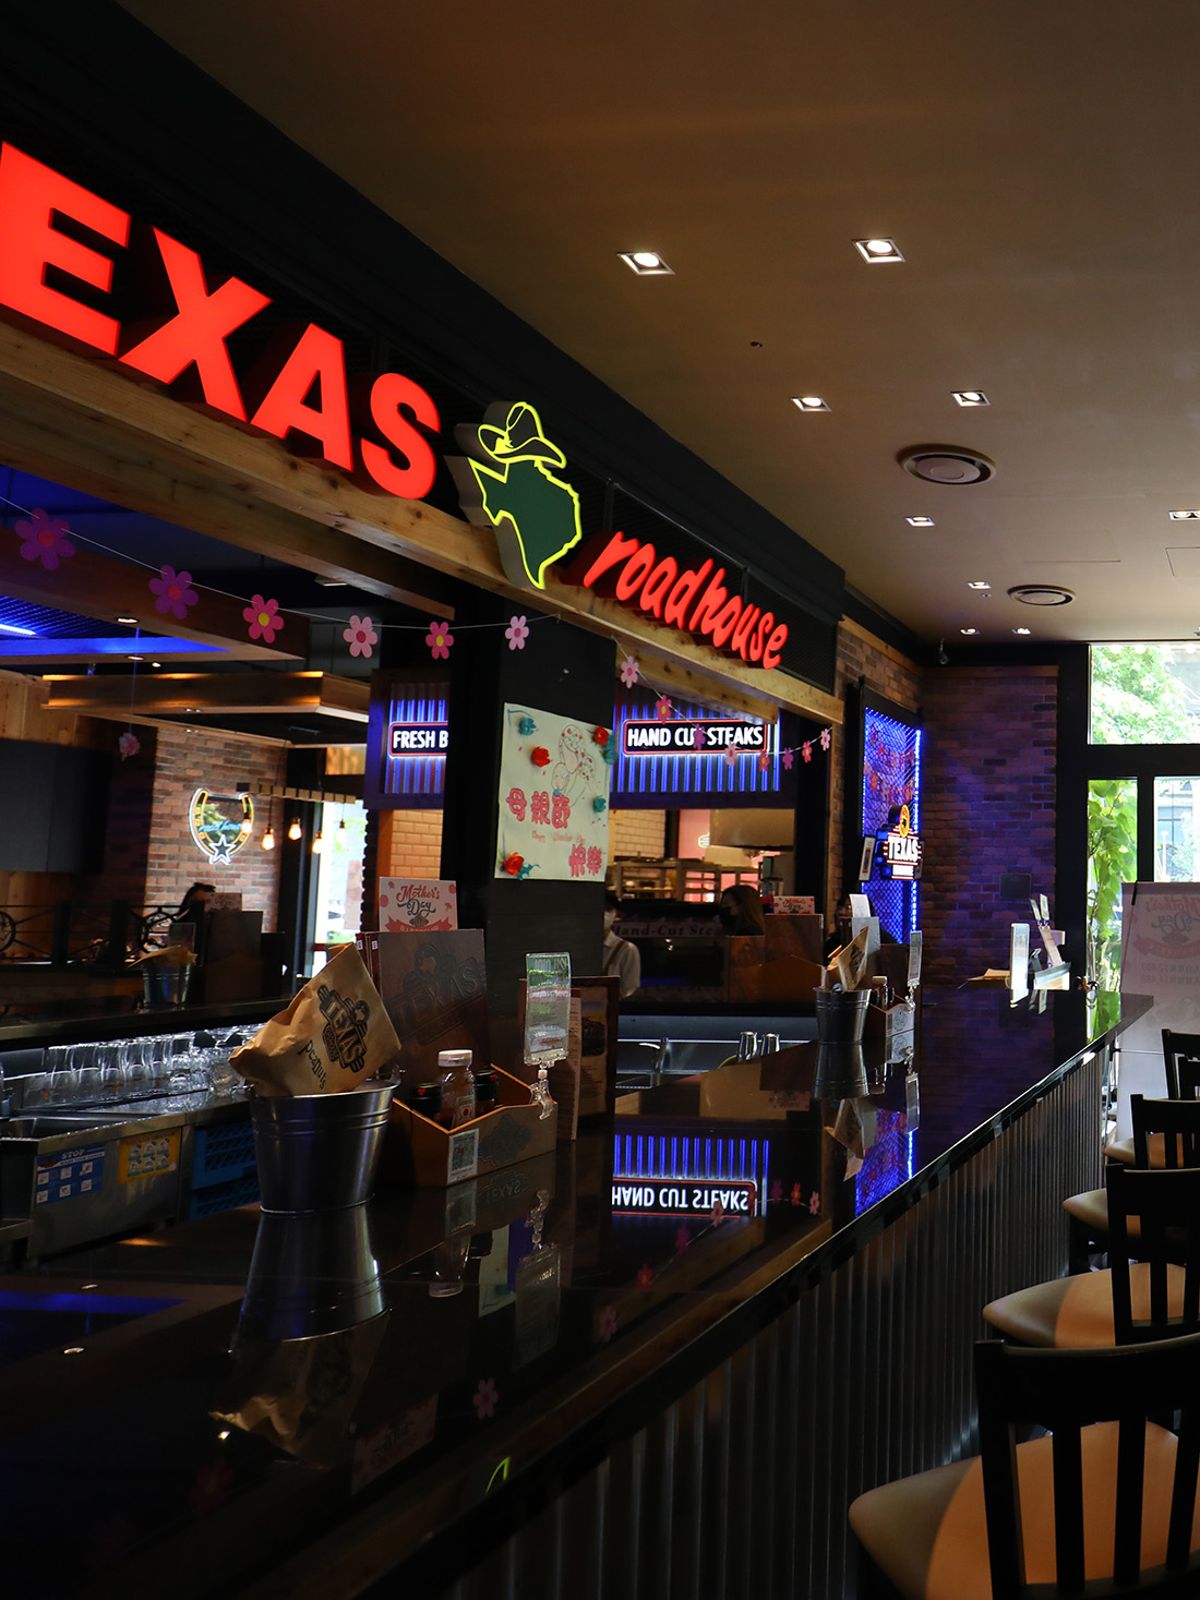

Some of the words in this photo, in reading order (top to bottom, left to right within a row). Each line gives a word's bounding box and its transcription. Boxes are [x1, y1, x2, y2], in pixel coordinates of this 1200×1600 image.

[0, 140, 441, 500] EXAS
[582, 531, 790, 671] roadhouse
[393, 730, 436, 749] FRESH
[627, 728, 671, 747] HAND
[674, 727, 704, 746] CU
[706, 727, 764, 746] STEAKS
[505, 787, 571, 830] 母親節
[887, 835, 918, 862] TEXAS
[397, 898, 437, 918] Day
[325, 998, 365, 1064] TEXAS
[297, 1038, 330, 1090] peanuts
